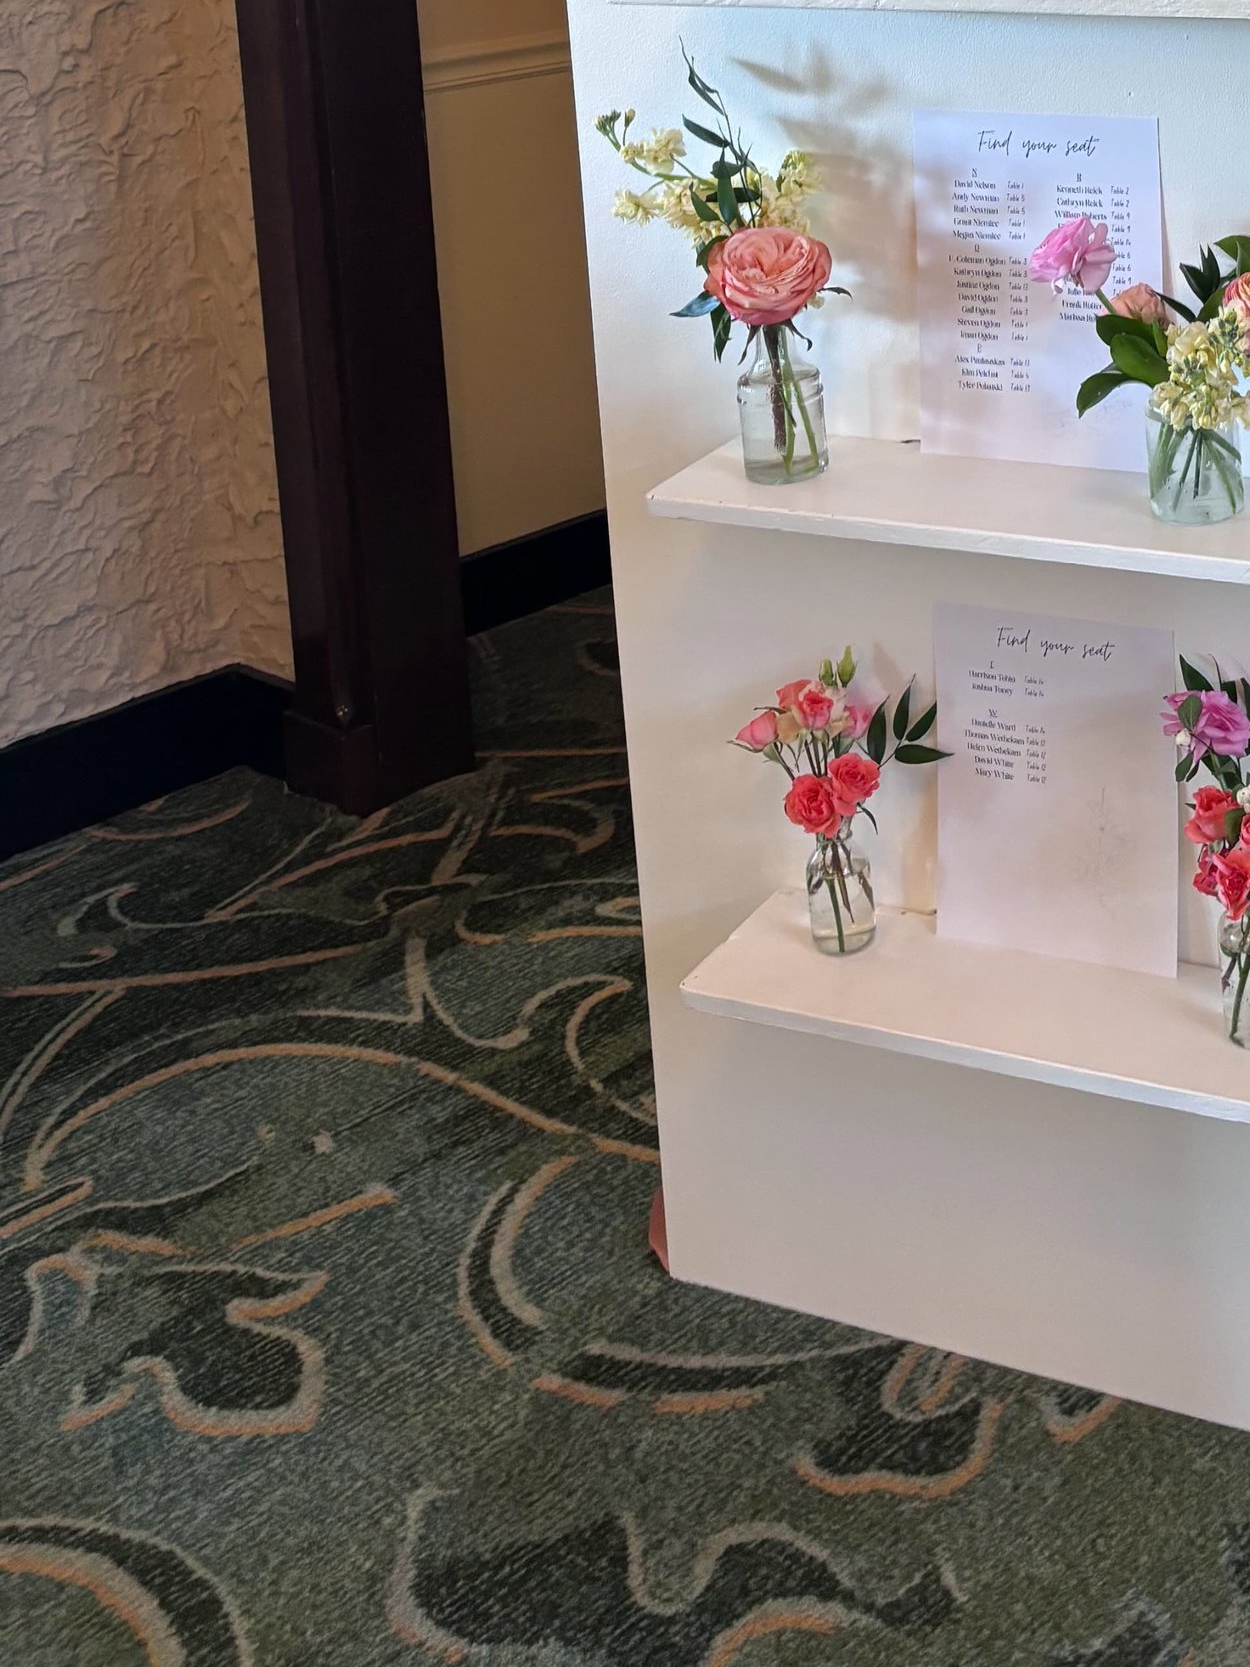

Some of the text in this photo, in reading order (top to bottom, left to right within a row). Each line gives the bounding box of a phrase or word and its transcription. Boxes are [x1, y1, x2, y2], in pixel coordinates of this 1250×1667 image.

[977, 130, 1100, 159] Find your seat
[1111, 186, 1125, 195] Table
[970, 205, 999, 215] Newman
[1007, 205, 1020, 214] Table
[996, 627, 1115, 661] Find your seat
[965, 729, 989, 740] Thomas
[1026, 737, 1039, 746] Table
[974, 755, 993, 764] David
[1027, 761, 1039, 770] Table
